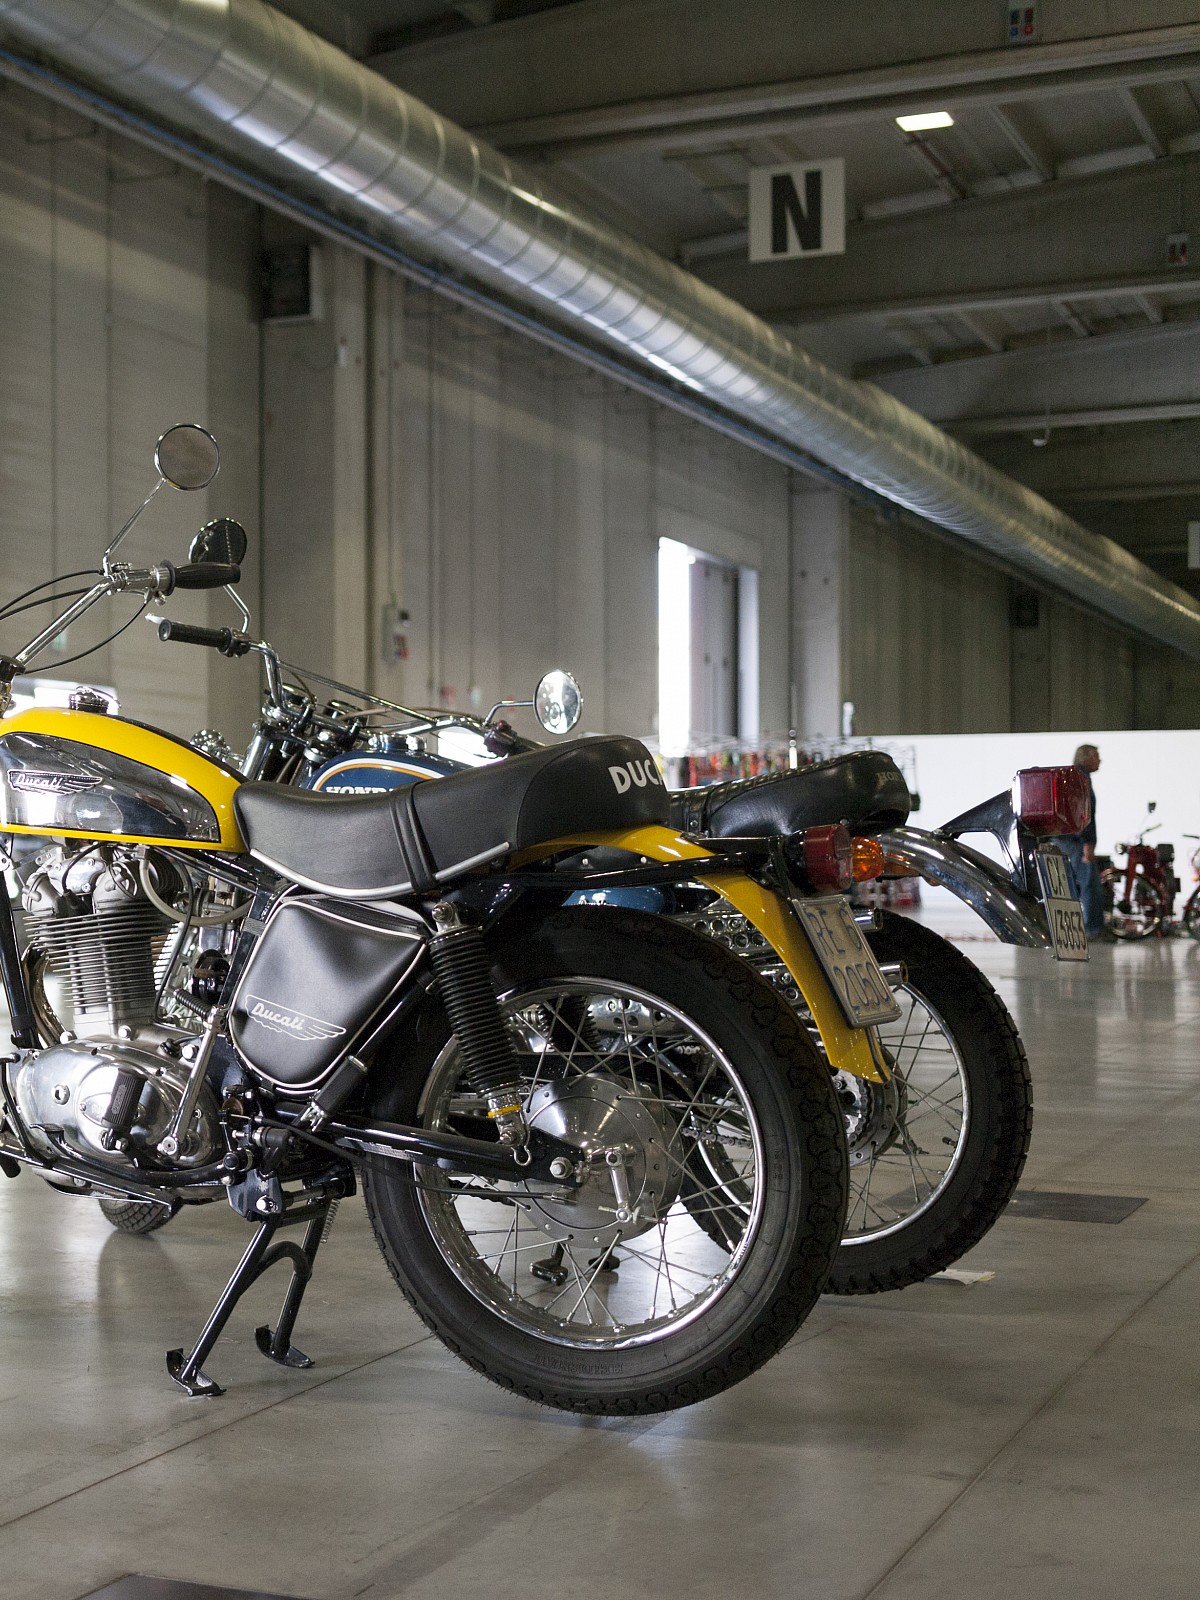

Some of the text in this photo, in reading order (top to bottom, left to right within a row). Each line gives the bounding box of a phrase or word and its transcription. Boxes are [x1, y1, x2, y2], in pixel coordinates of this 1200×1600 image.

[771, 170, 822, 253] N
[15, 773, 63, 790] Ducati
[608, 759, 662, 794] DUC
[1046, 855, 1065, 897] CX
[806, 908, 845, 958] RE
[1054, 908, 1087, 950] 13853
[833, 961, 890, 1011] 2050
[251, 1002, 305, 1030] Ducati
